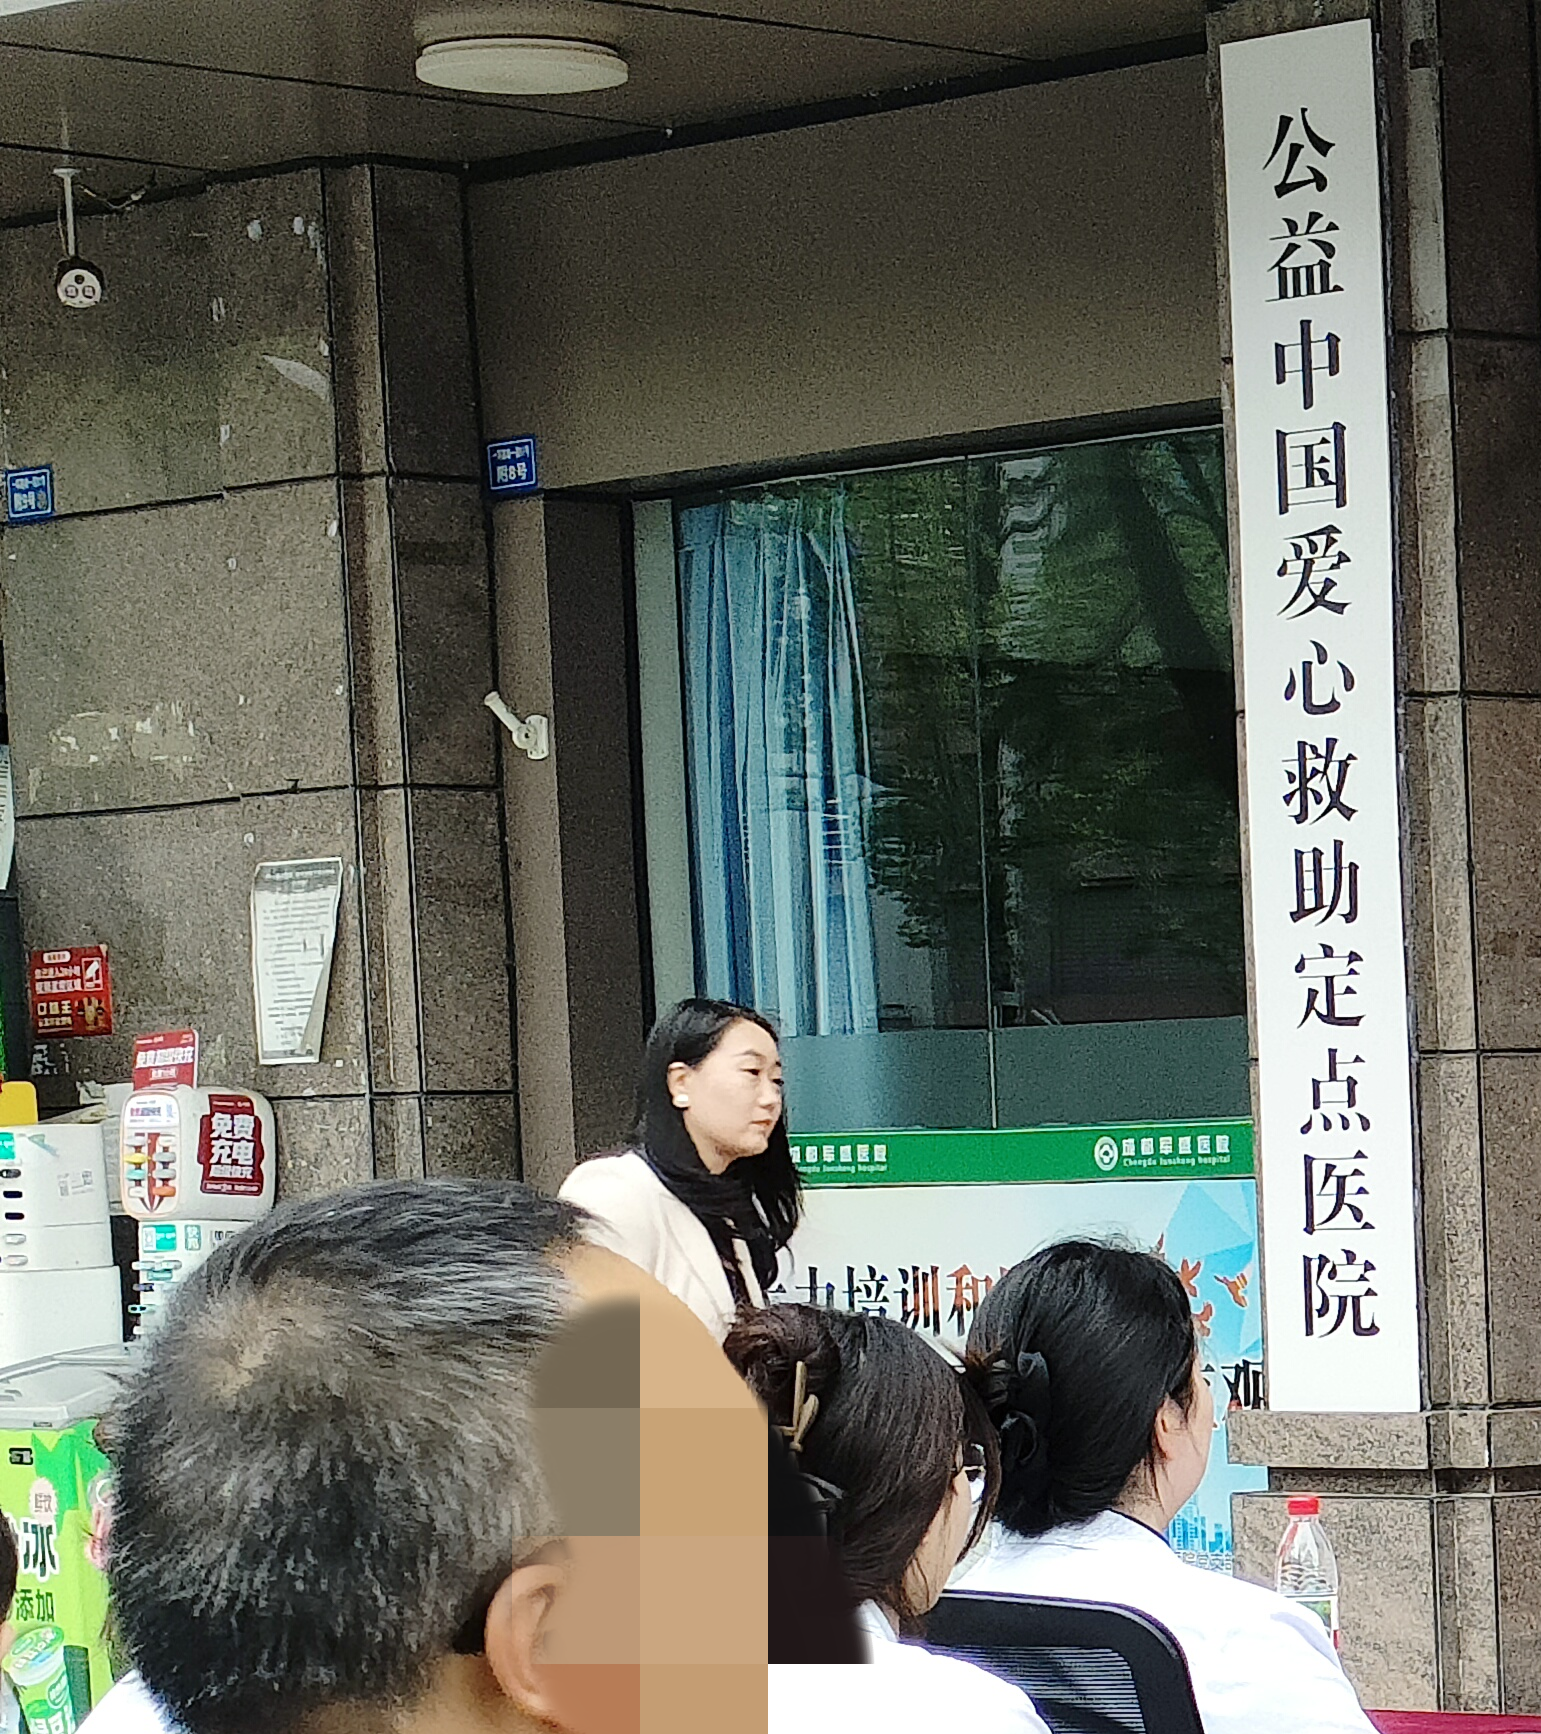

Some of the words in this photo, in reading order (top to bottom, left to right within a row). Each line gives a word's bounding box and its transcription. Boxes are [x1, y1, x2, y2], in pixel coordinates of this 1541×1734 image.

[1262, 107, 1380, 1340] 公益中国爱心救助定点医院
[210, 1112, 255, 1138] 免费
[210, 1139, 255, 1165] 充电
[1122, 1135, 1230, 1156] 成都军盛医院
[768, 1264, 1008, 1337] 力培训和
[16, 1589, 55, 1622] 添加
